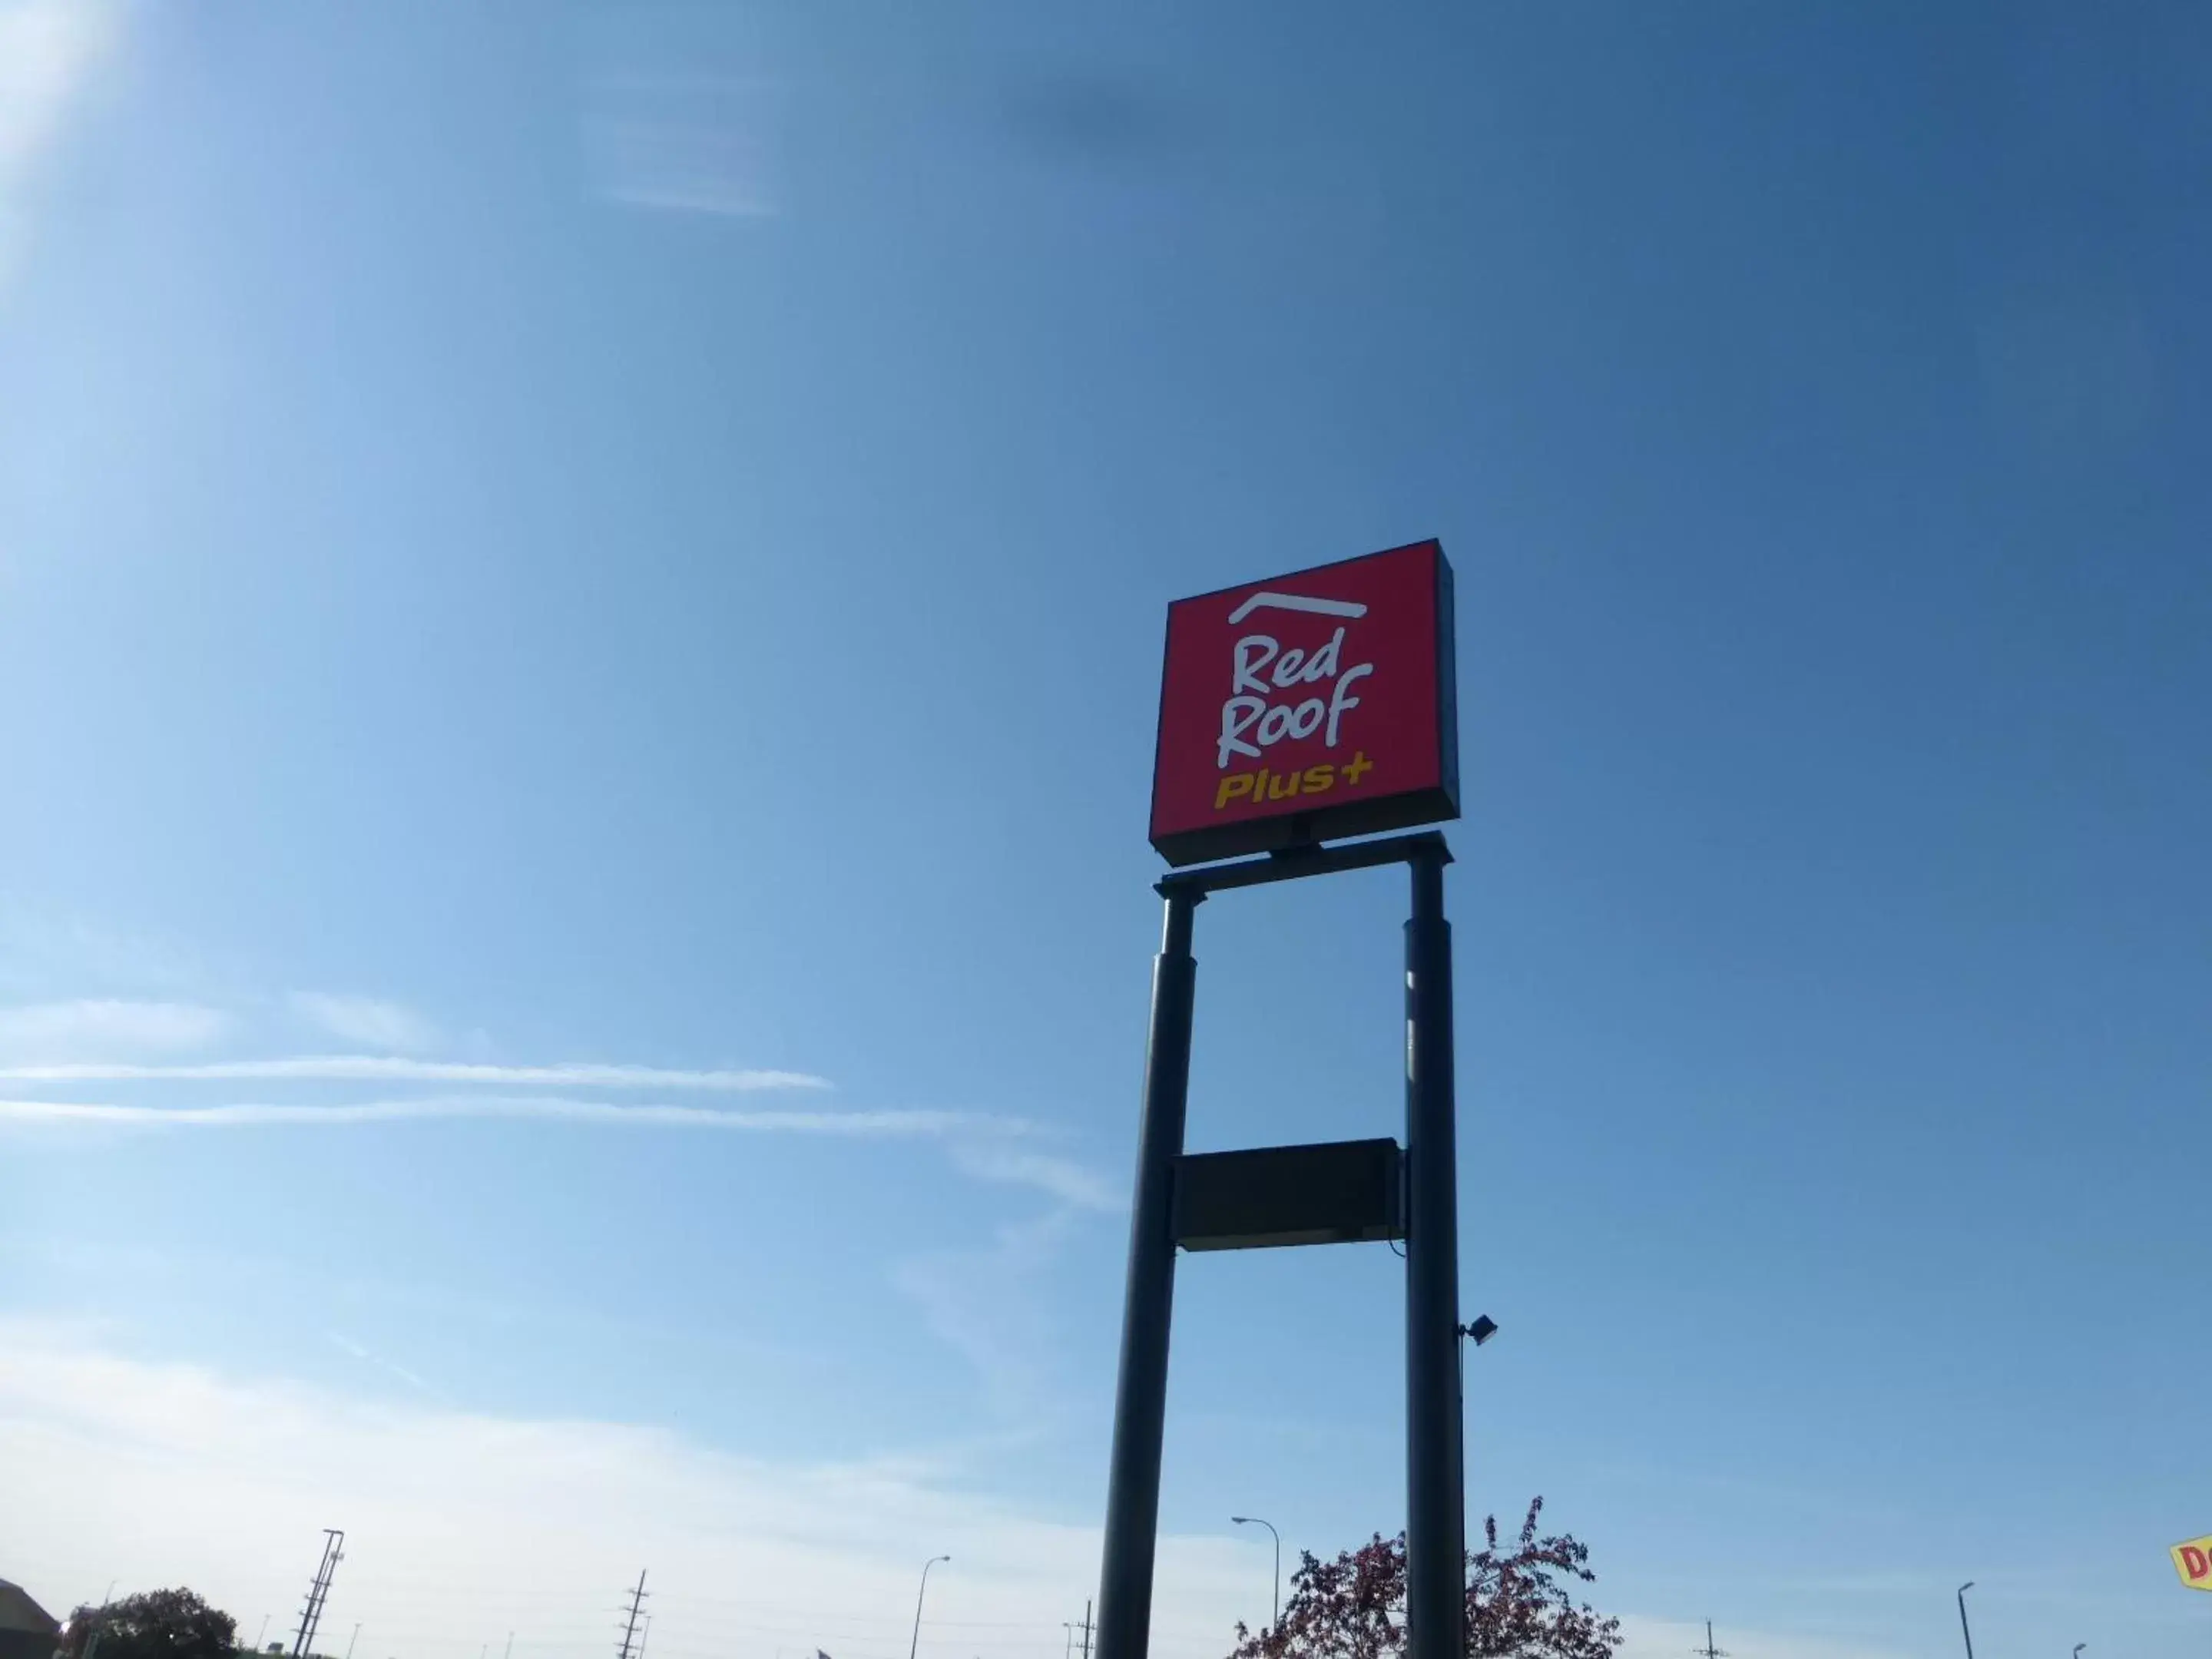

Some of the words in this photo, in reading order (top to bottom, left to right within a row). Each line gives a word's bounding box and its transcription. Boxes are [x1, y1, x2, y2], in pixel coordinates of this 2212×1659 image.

[1233, 628, 1345, 694] Red
[1217, 664, 1373, 768] Roof
[1215, 752, 1373, 808] Plus+
[2178, 1546, 2212, 1579] D
